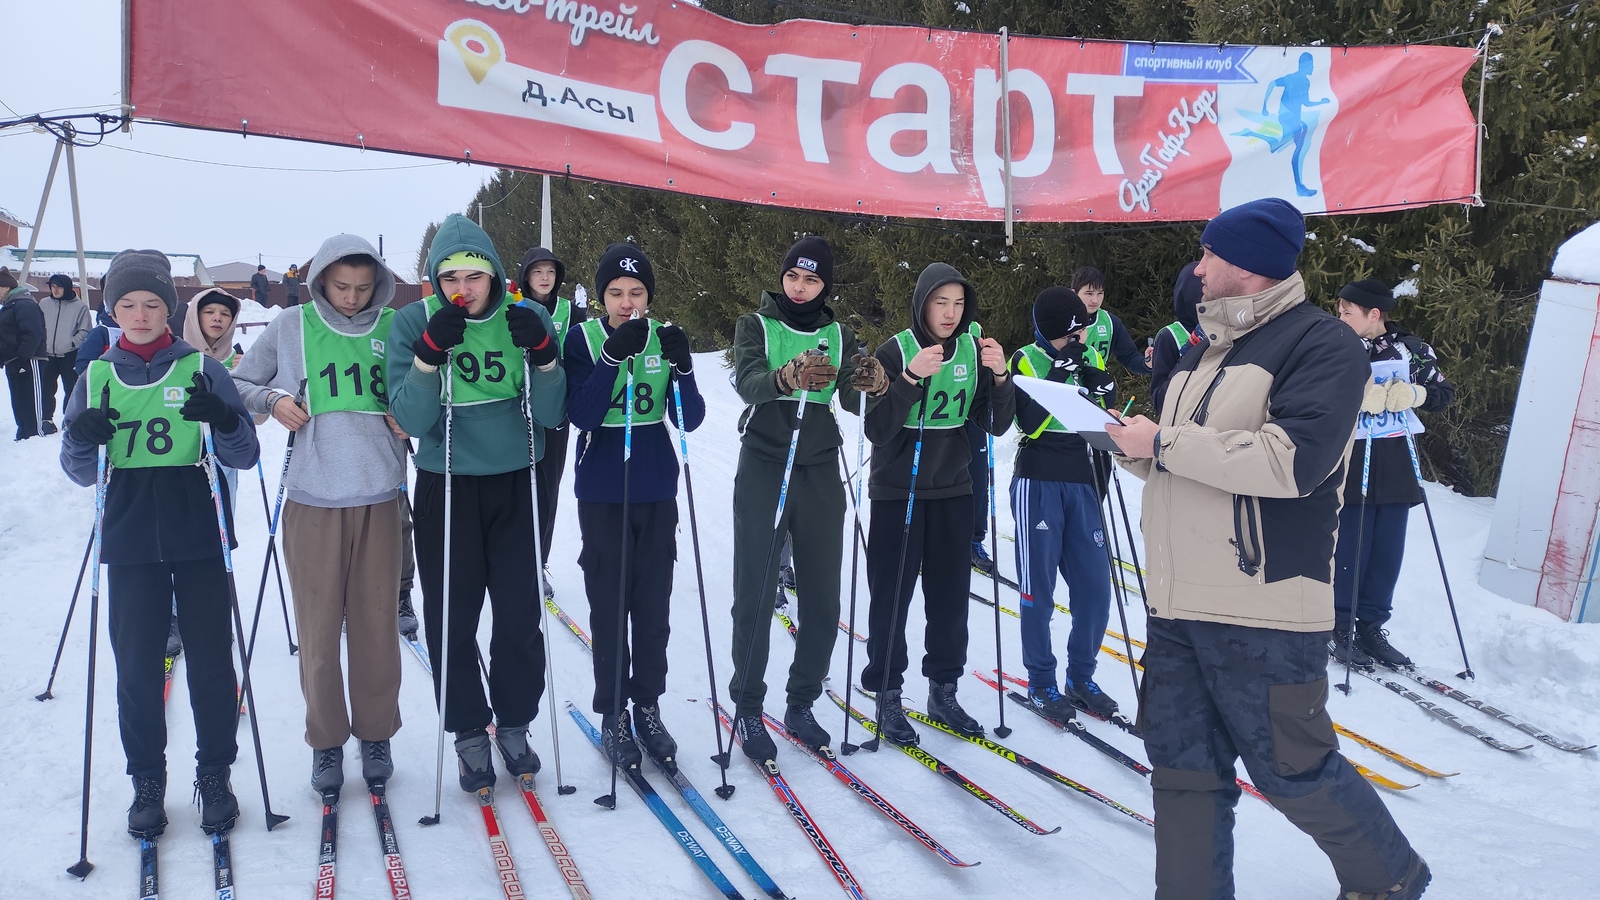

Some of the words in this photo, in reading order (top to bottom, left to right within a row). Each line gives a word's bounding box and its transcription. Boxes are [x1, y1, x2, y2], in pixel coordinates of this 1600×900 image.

[1134, 56, 1203, 72] спортивный
[1205, 56, 1232, 73] клуб
[456, 351, 506, 383] 95
[609, 383, 654, 415] 48
[117, 417, 173, 458] 78
[676, 830, 707, 860] DEWAY
[715, 825, 747, 856] DEWAY
